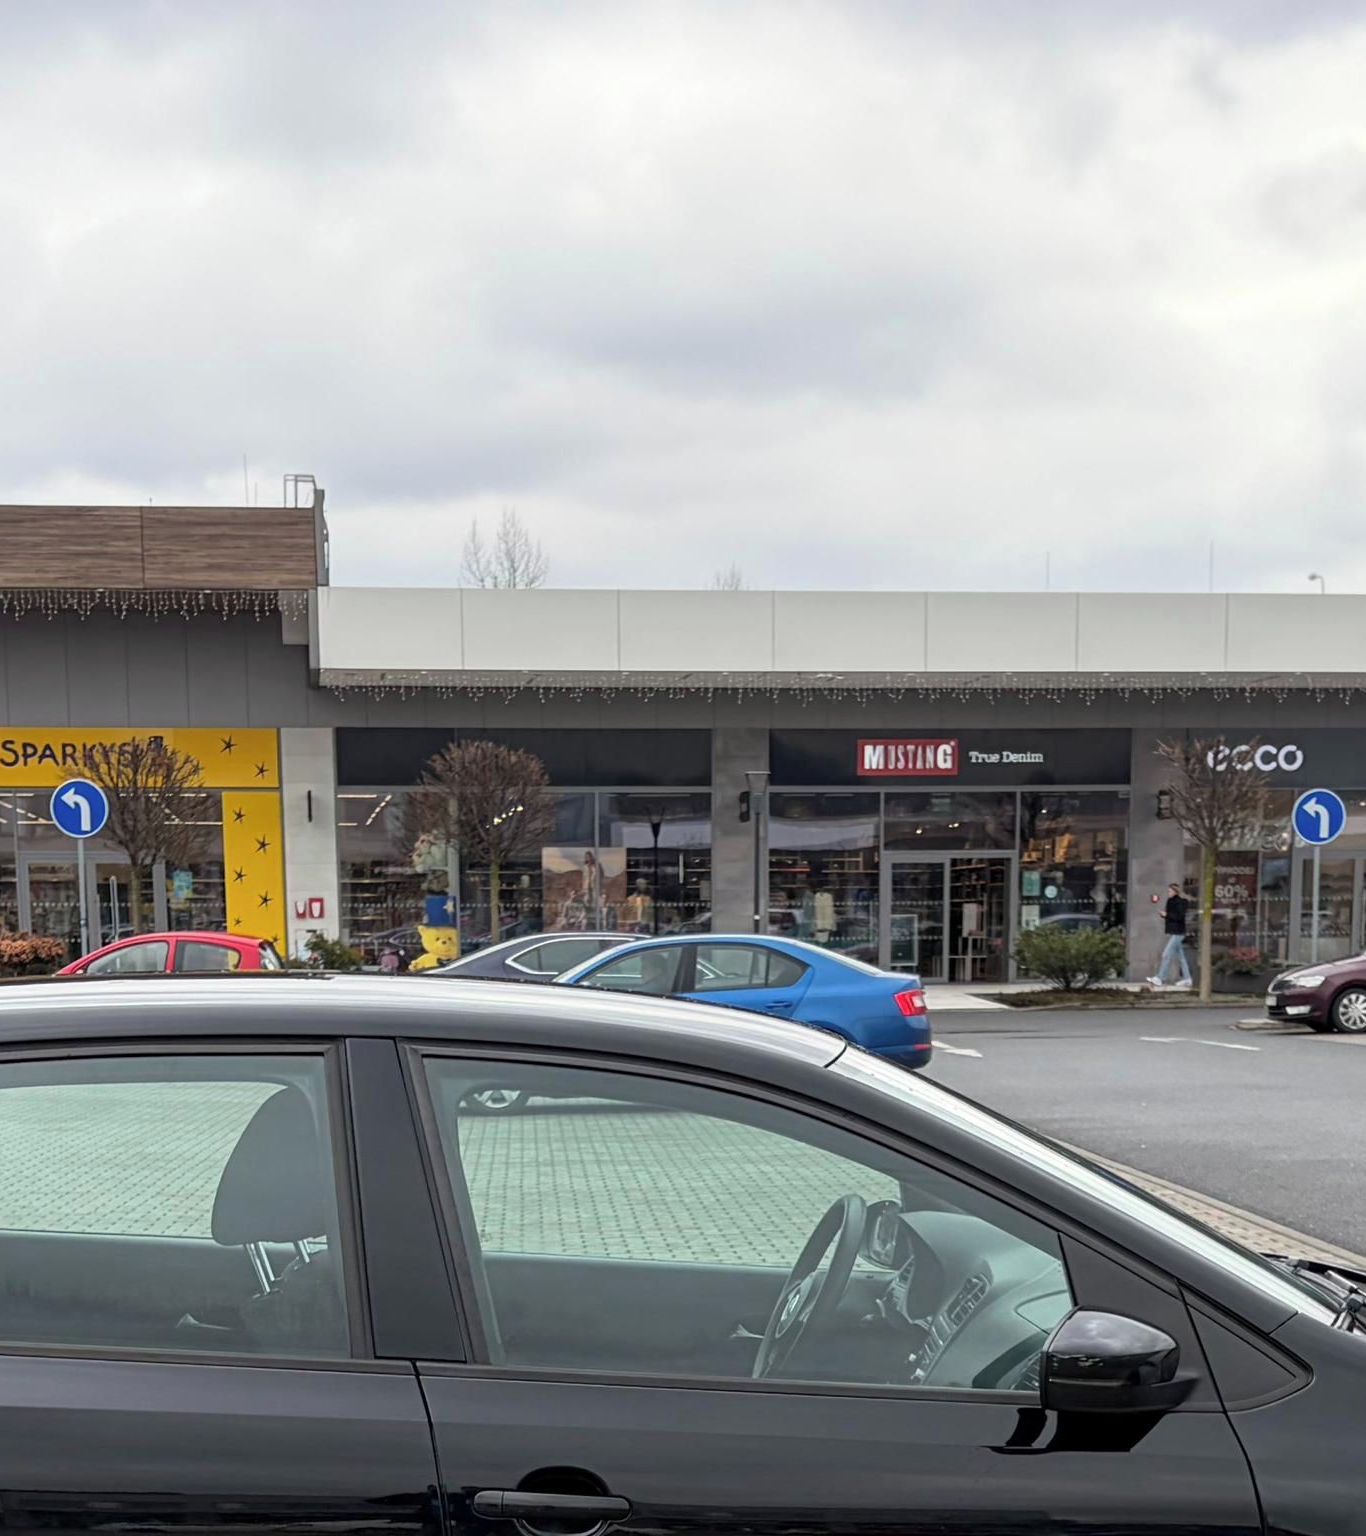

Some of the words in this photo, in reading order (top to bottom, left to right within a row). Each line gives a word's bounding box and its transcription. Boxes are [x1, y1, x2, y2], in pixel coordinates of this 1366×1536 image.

[863, 743, 954, 770] MUSTANG
[969, 751, 1000, 763] True
[1002, 752, 1044, 763] Denim
